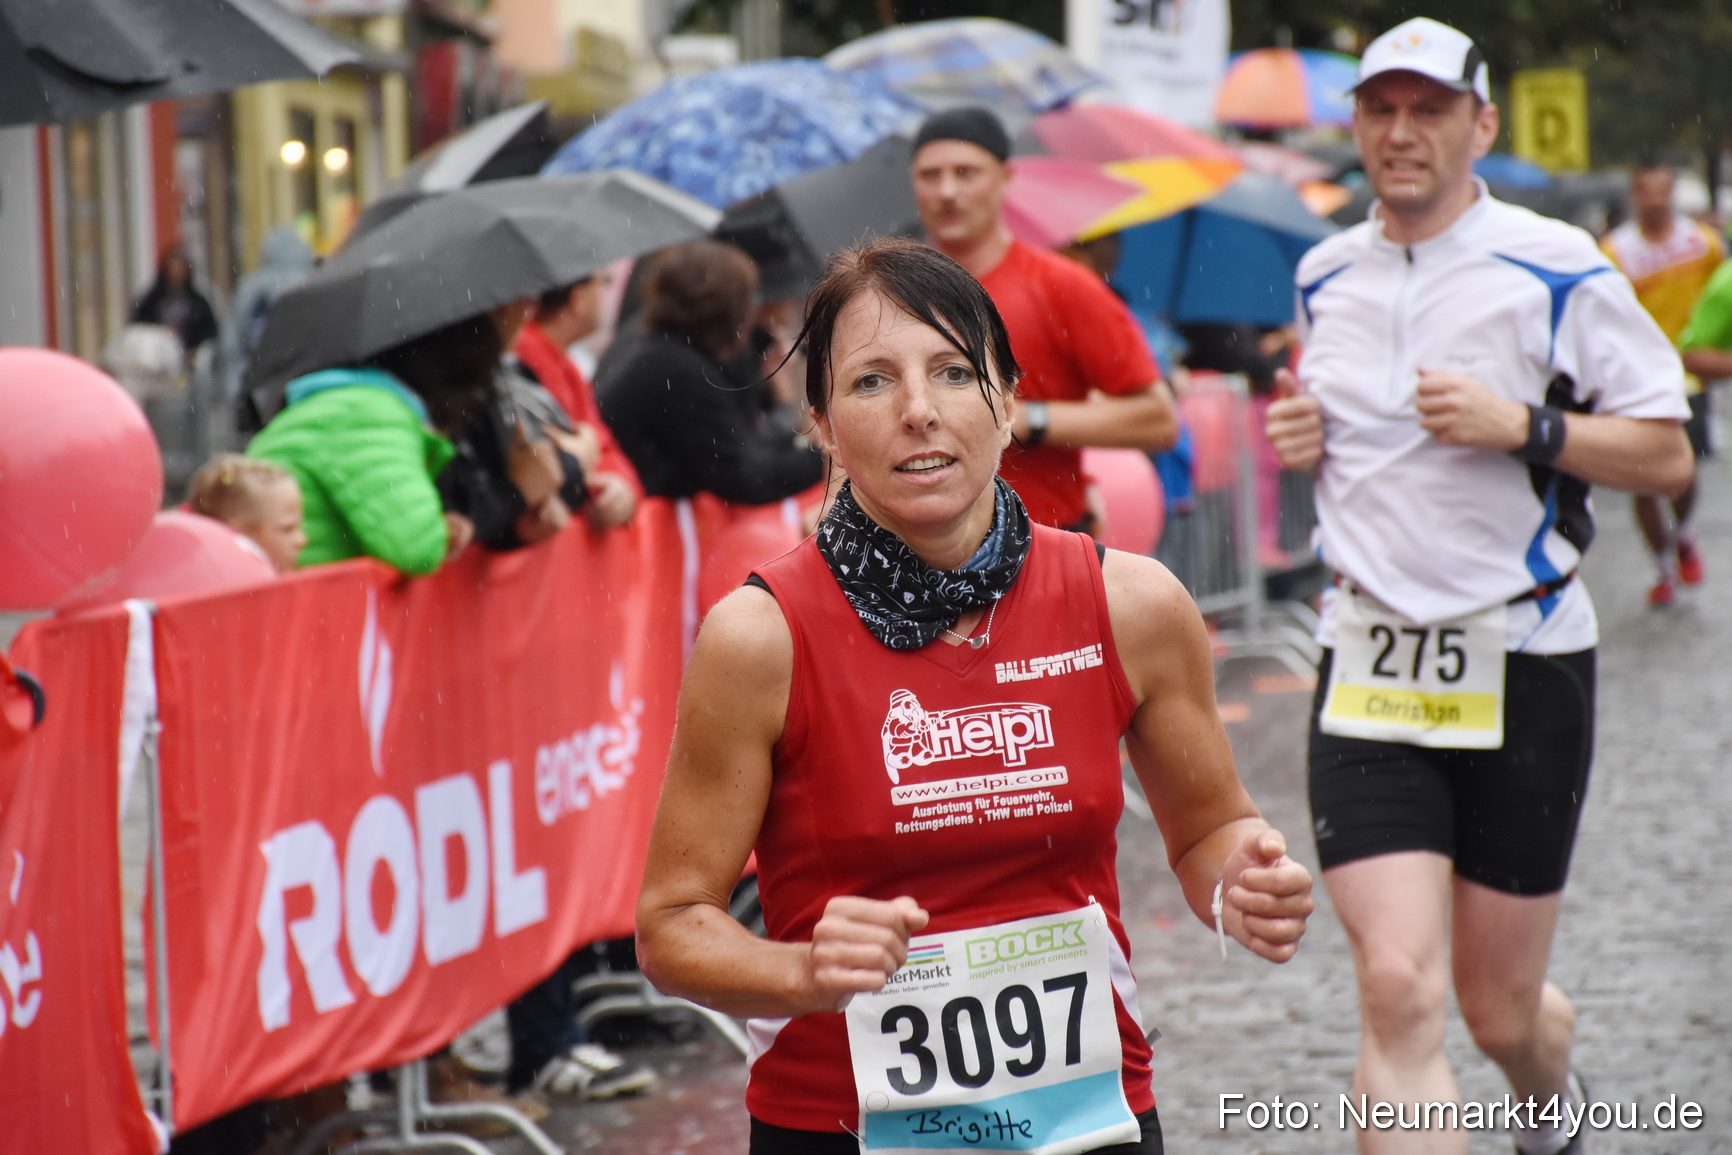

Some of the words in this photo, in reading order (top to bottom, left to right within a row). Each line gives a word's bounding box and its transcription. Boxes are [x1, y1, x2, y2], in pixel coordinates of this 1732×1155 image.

[1369, 624, 1467, 684] 275
[896, 770, 1065, 800] www.helpi.com
[912, 804, 973, 819] Ausrüstung
[974, 798, 991, 811] für
[992, 790, 1055, 808] Feuerwehr,
[984, 807, 1011, 822] THW
[1013, 804, 1034, 818] und
[1036, 800, 1073, 815] Polizei
[964, 919, 1087, 969] BOCK
[969, 965, 1005, 980] inspired
[1006, 962, 1018, 973] by
[1020, 957, 1045, 969] smart
[1047, 948, 1088, 963] concepts
[880, 971, 1088, 1096] 3097
[906, 1110, 1033, 1143] Brigitte
